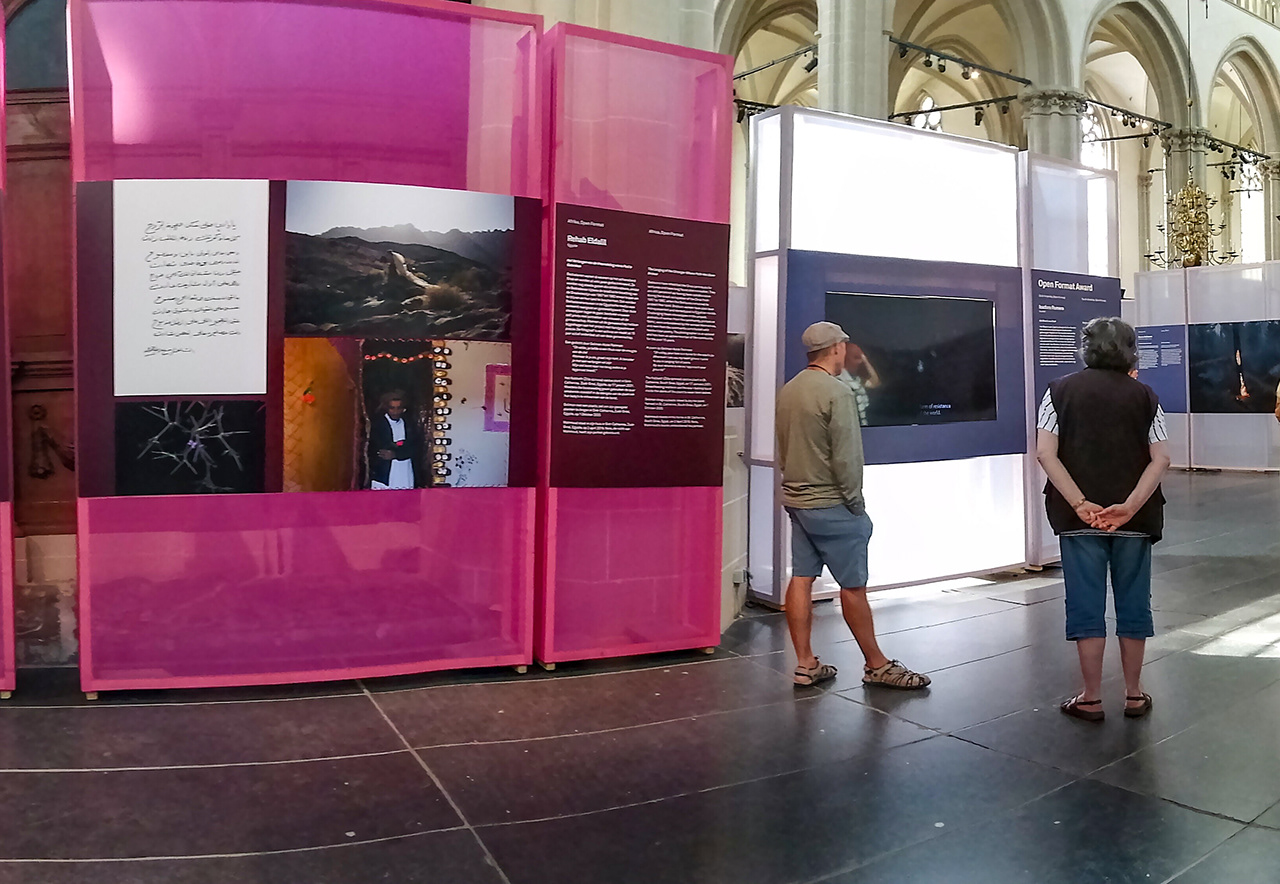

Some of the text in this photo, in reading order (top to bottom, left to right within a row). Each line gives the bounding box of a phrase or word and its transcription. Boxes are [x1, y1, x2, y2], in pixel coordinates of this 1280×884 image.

[1038, 280, 1093, 291] Open Format Award
